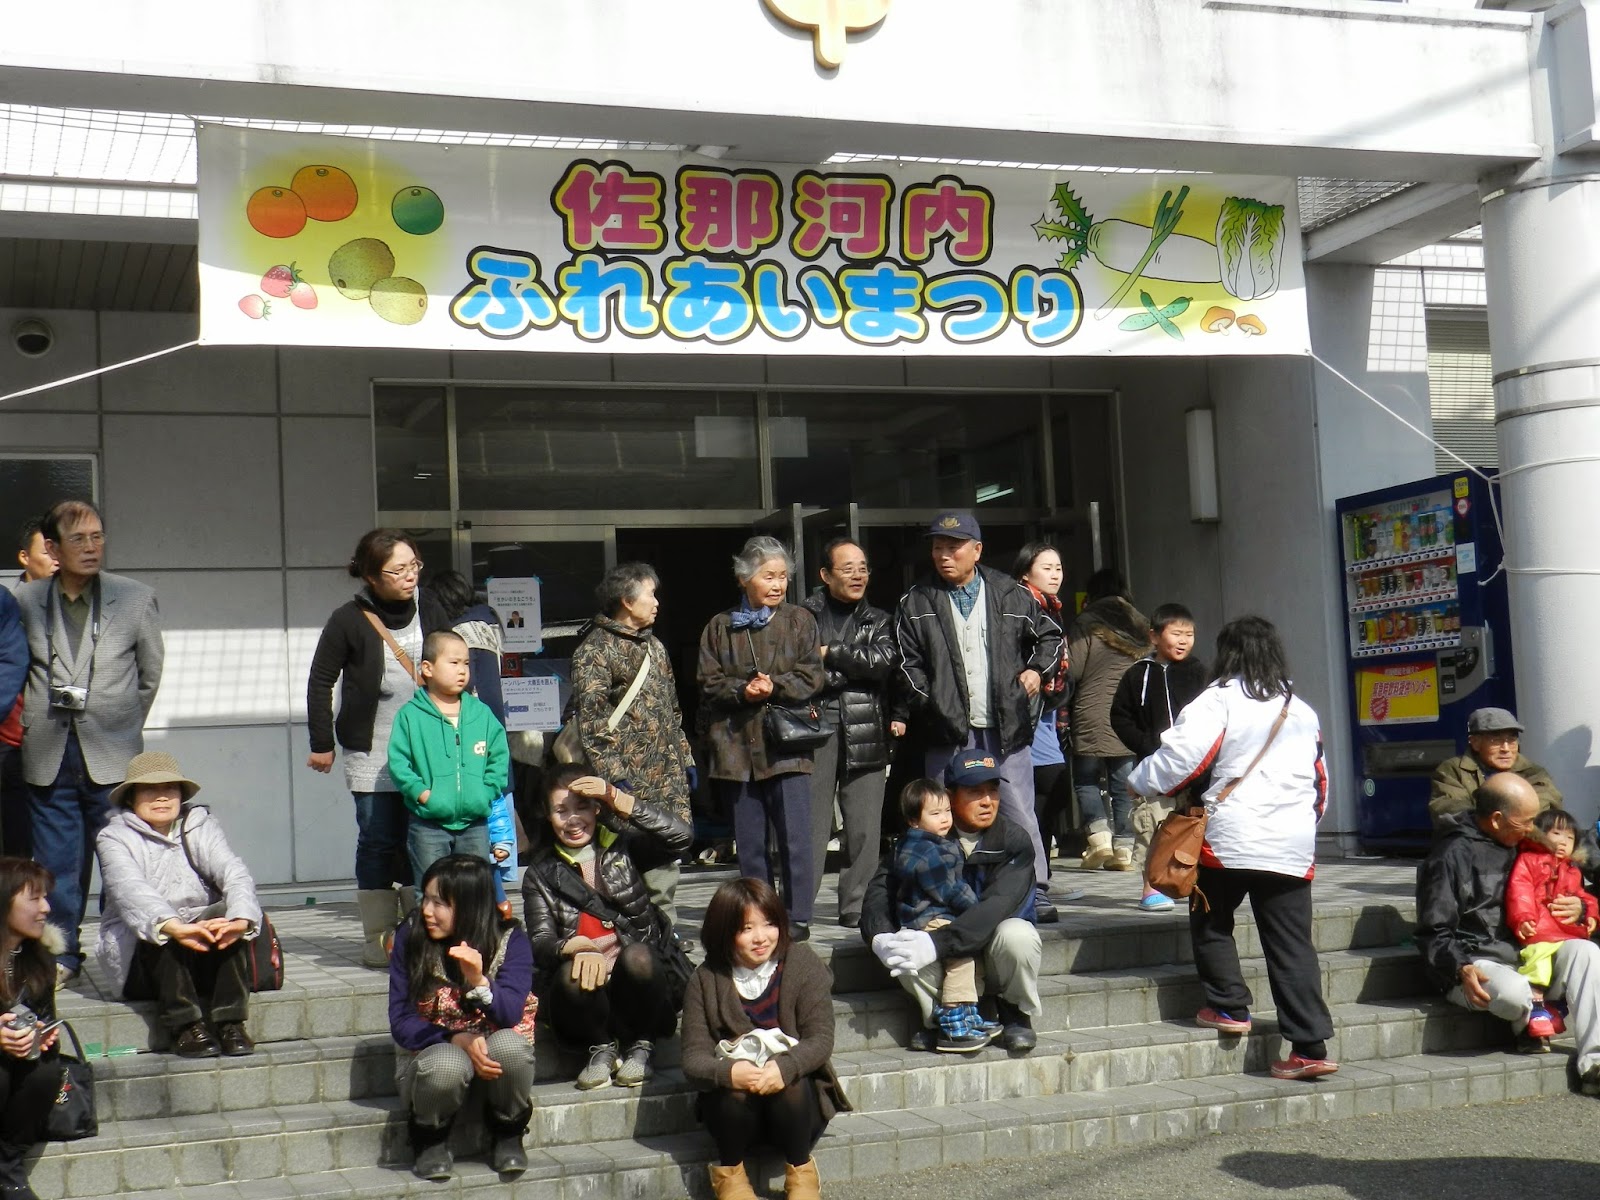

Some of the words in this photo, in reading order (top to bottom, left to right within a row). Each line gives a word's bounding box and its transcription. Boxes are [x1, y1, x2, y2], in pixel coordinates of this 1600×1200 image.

[551, 159, 994, 265] 佐那河内
[449, 246, 1084, 347] ふれあいまつり
